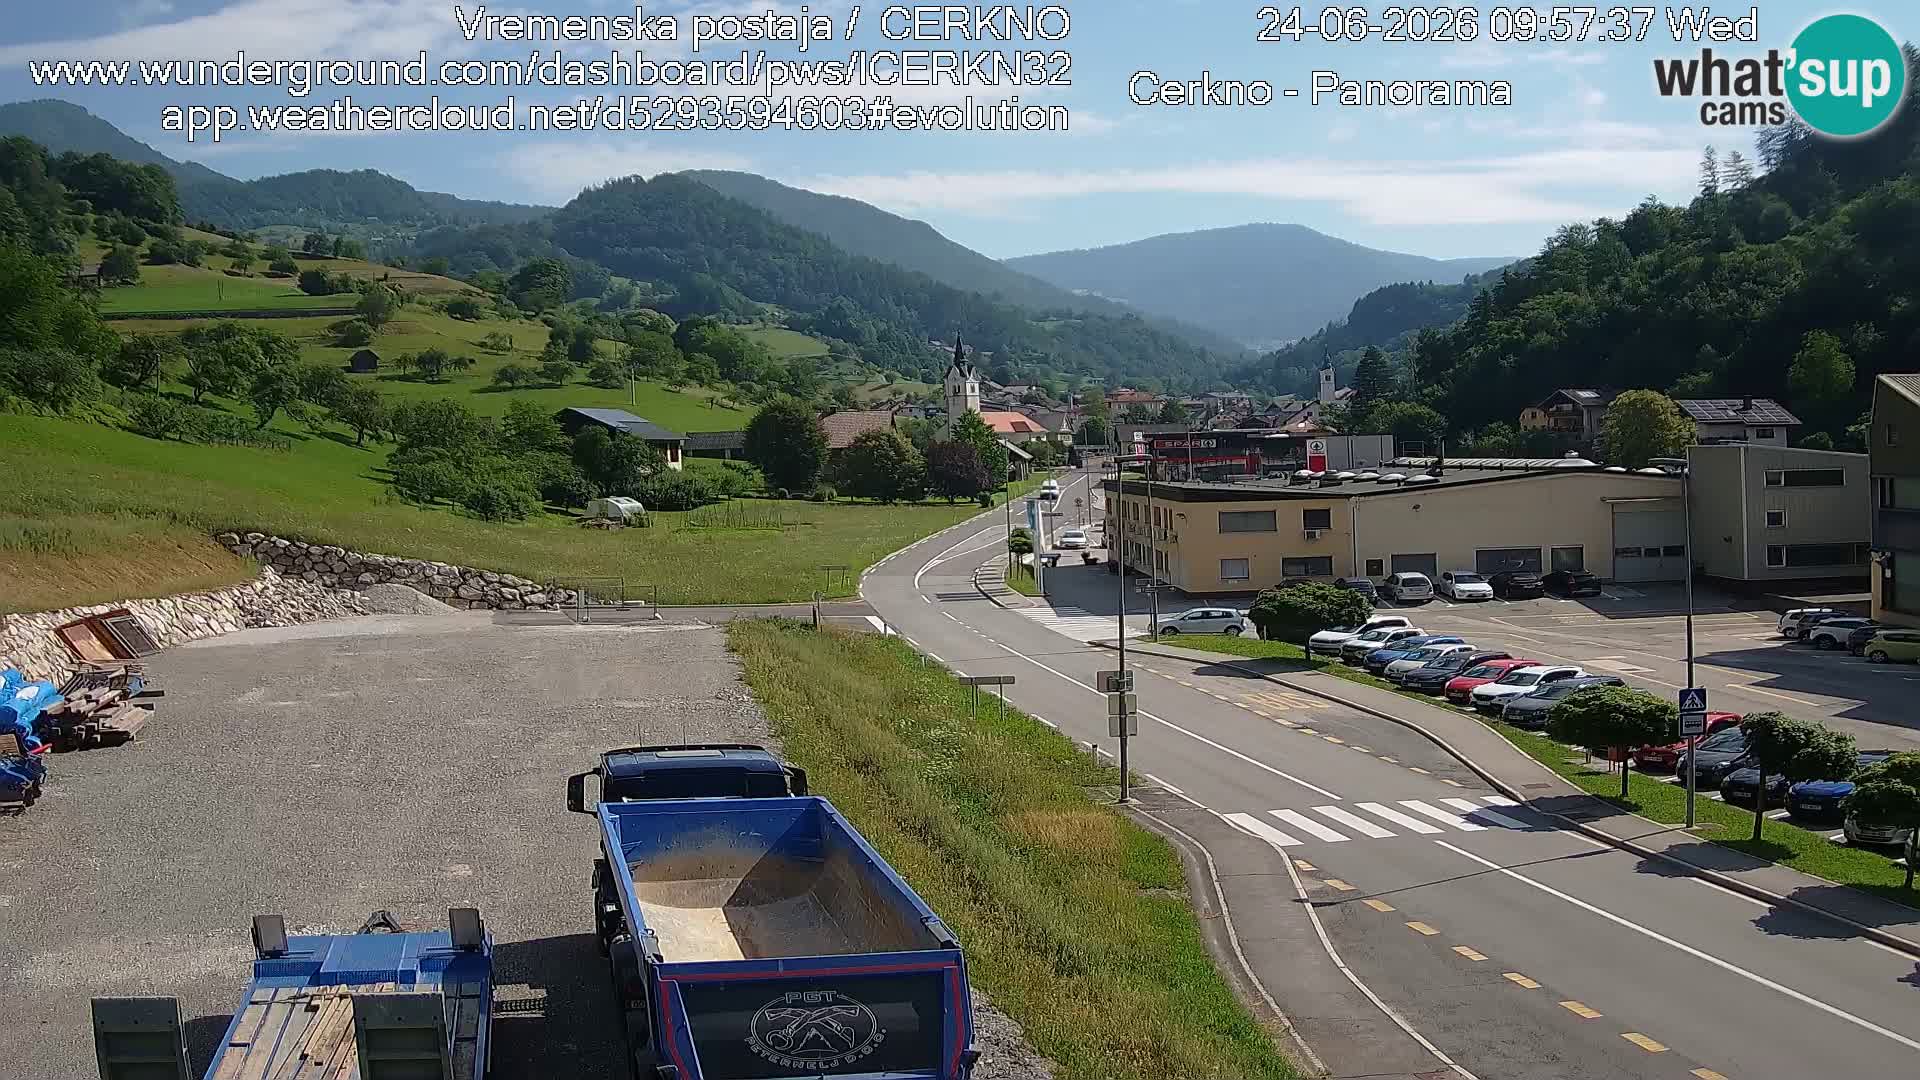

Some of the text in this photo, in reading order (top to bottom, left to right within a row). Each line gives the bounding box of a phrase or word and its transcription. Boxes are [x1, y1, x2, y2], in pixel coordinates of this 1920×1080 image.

[1165, 440, 1201, 448] SPAR
[785, 990, 837, 1004] PGT
[744, 1036, 840, 1069] PETERNELJ
